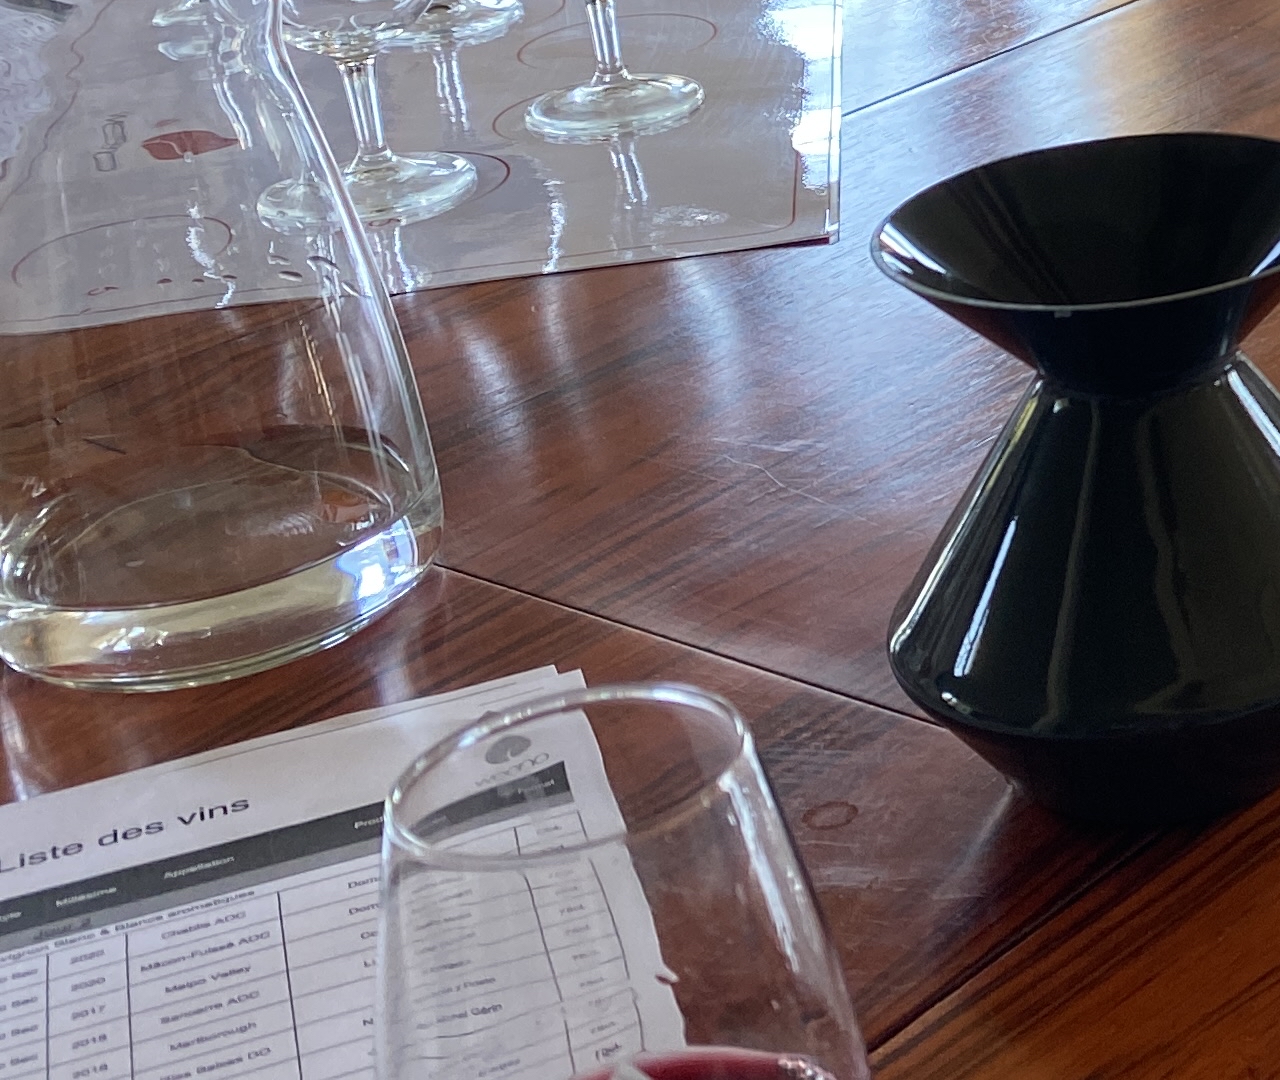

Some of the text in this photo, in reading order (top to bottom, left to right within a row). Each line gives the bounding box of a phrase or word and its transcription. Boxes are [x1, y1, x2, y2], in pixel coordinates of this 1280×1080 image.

[0, 798, 250, 872] Liste des vins
[210, 965, 252, 981] Valley
